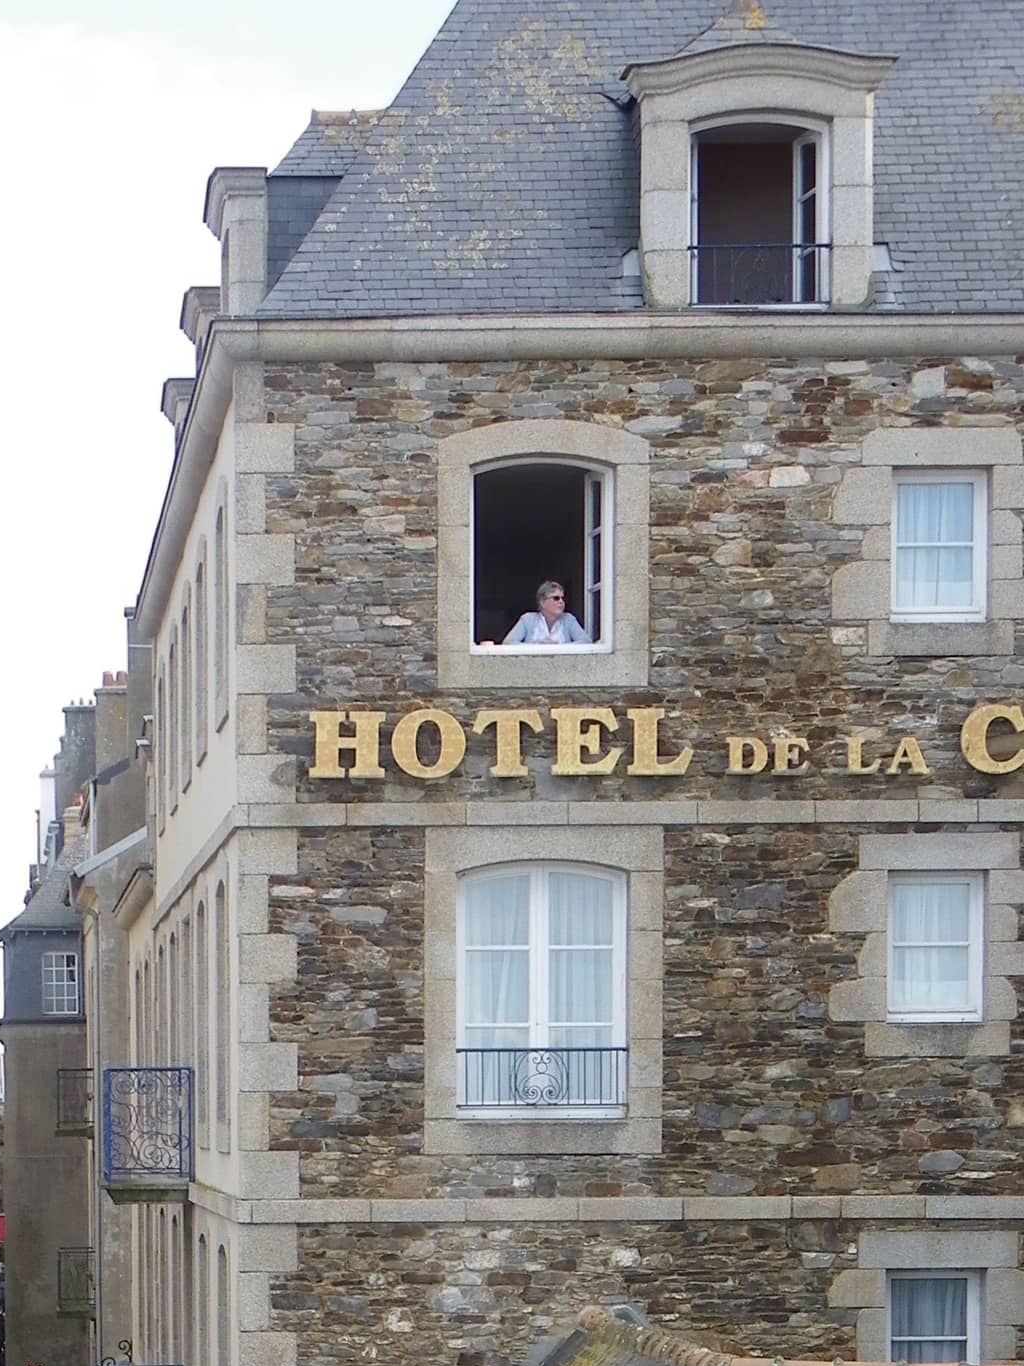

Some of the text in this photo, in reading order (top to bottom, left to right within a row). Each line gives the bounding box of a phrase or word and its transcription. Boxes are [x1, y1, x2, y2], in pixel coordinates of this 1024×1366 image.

[308, 706, 694, 779] HOTEL
[725, 736, 812, 775] DE
[846, 736, 930, 777] LA
